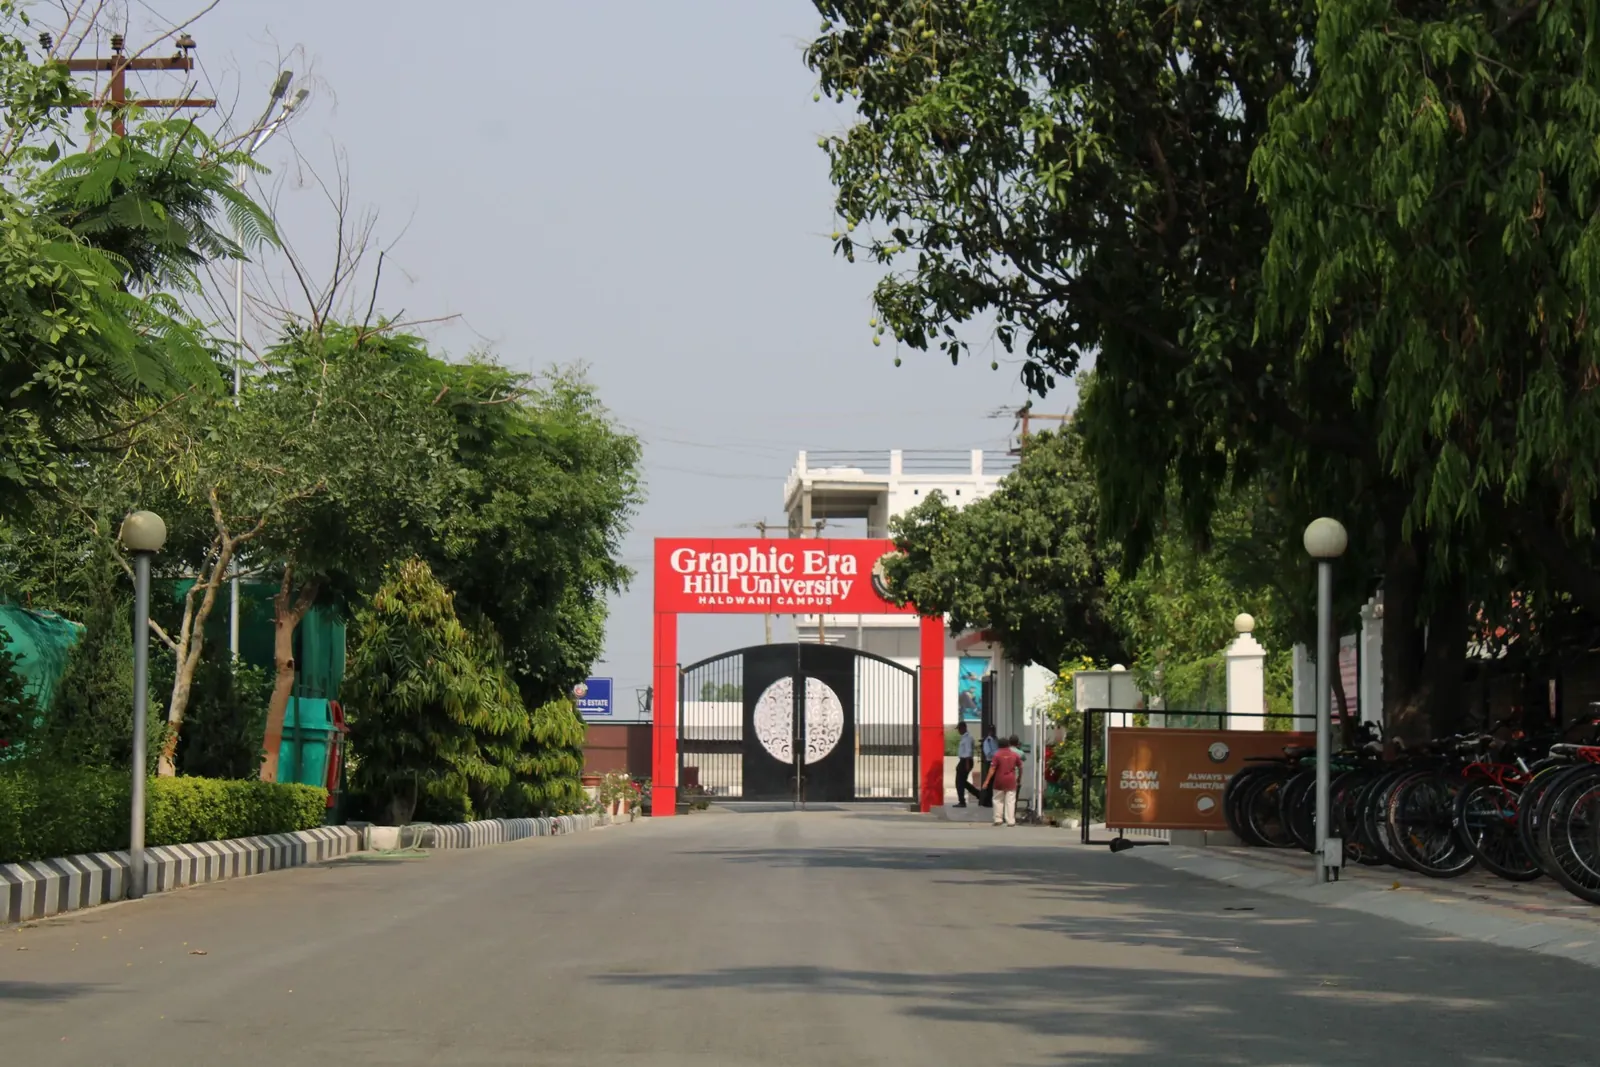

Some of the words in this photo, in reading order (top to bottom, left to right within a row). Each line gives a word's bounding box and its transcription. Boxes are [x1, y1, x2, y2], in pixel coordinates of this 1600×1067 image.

[670, 546, 795, 580] Graphic
[802, 550, 858, 575] Era
[683, 573, 729, 594] Hill
[740, 573, 854, 600] University
[698, 596, 771, 605] HALDWANI
[776, 596, 832, 606] CAMPUS
[587, 699, 609, 707] ESTATE
[1121, 769, 1158, 780] SLOW
[1187, 772, 1222, 781] ALWAYS
[1119, 780, 1160, 790] DOWN
